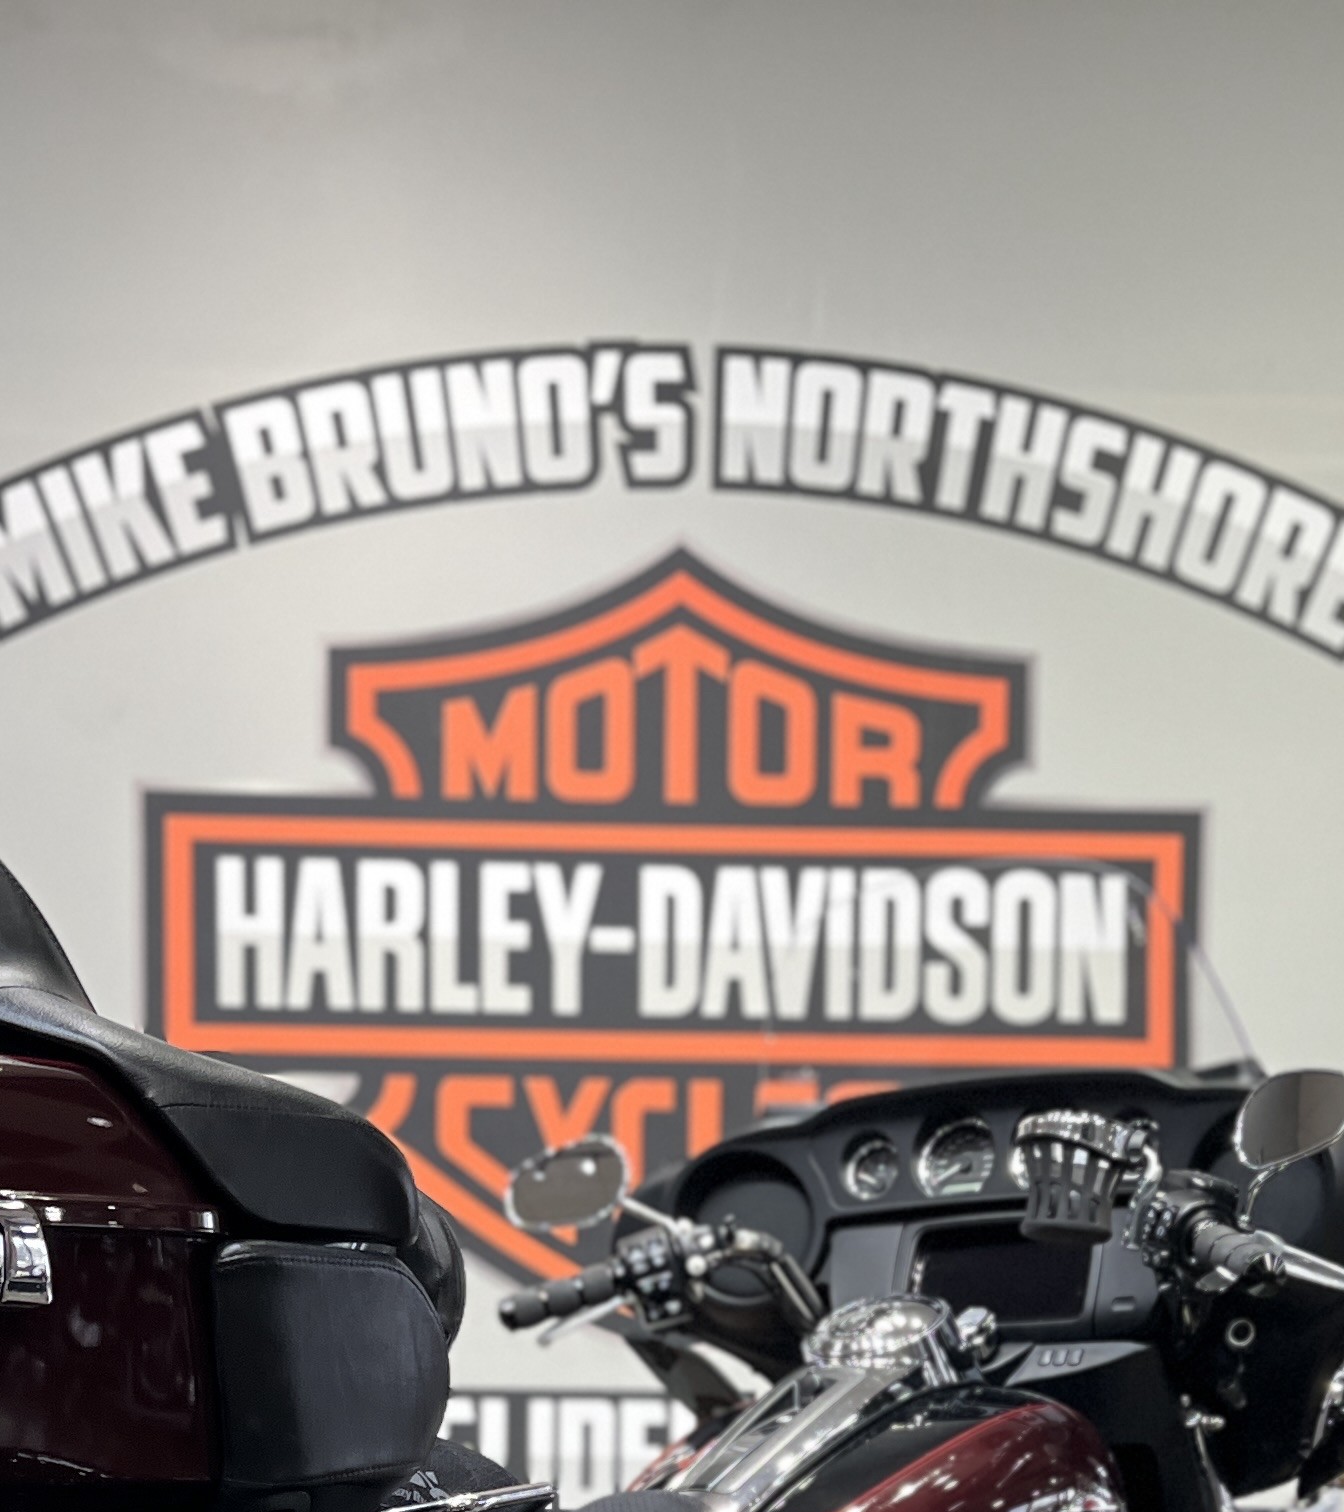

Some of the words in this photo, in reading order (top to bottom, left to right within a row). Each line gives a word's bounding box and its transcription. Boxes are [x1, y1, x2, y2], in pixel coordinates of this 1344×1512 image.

[222, 348, 690, 533] BRUNO'S
[441, 624, 923, 807] MOTOR
[213, 854, 1128, 1026] HARLEY-DAVIDSON
